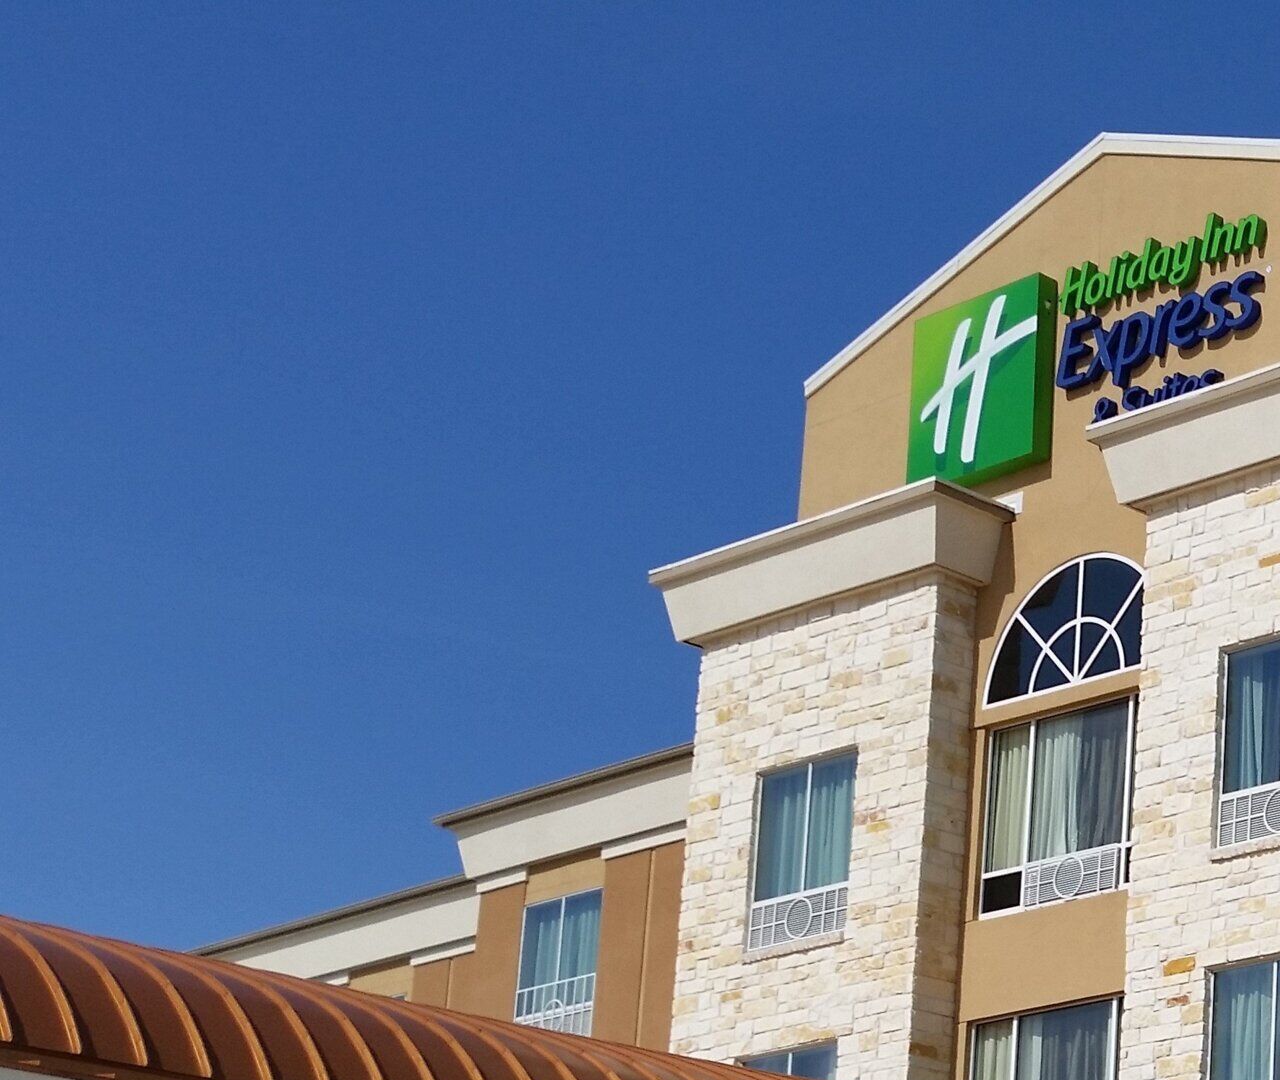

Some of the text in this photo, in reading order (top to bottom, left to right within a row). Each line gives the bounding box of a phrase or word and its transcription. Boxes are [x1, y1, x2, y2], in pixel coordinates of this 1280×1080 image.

[1060, 213, 1267, 316] Holiday Inn
[1056, 271, 1265, 389] Express
